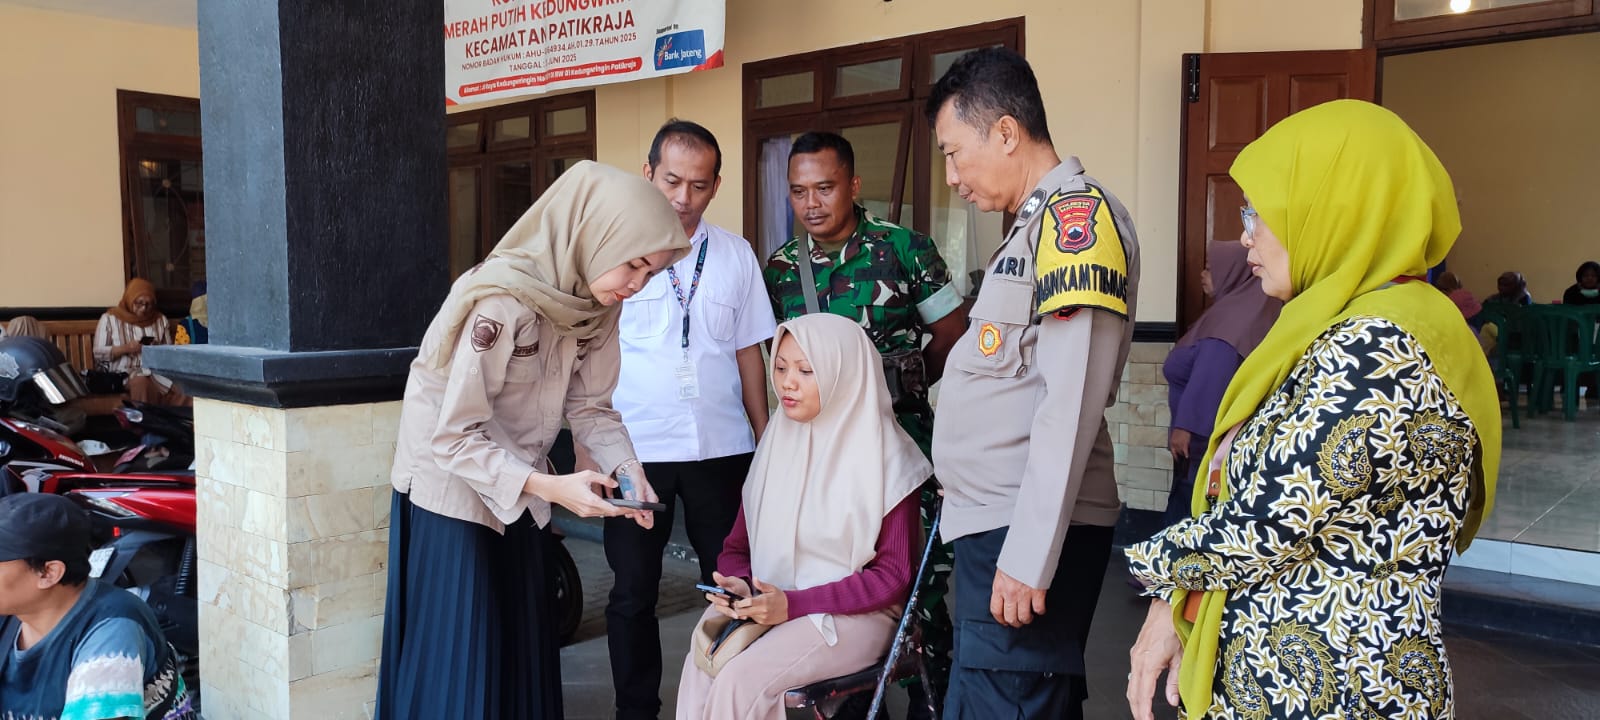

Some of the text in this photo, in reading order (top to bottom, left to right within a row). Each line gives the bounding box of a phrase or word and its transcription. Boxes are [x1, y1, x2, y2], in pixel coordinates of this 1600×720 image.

[444, 16, 488, 39] MERAH
[491, 5, 526, 31] PUTIH
[465, 10, 635, 58] KECAMATAN PATIKRAJA
[620, 32, 637, 42] 2025
[509, 61, 541, 72] TANGGAL
[562, 53, 577, 63] 2025
[664, 48, 679, 61] Bank
